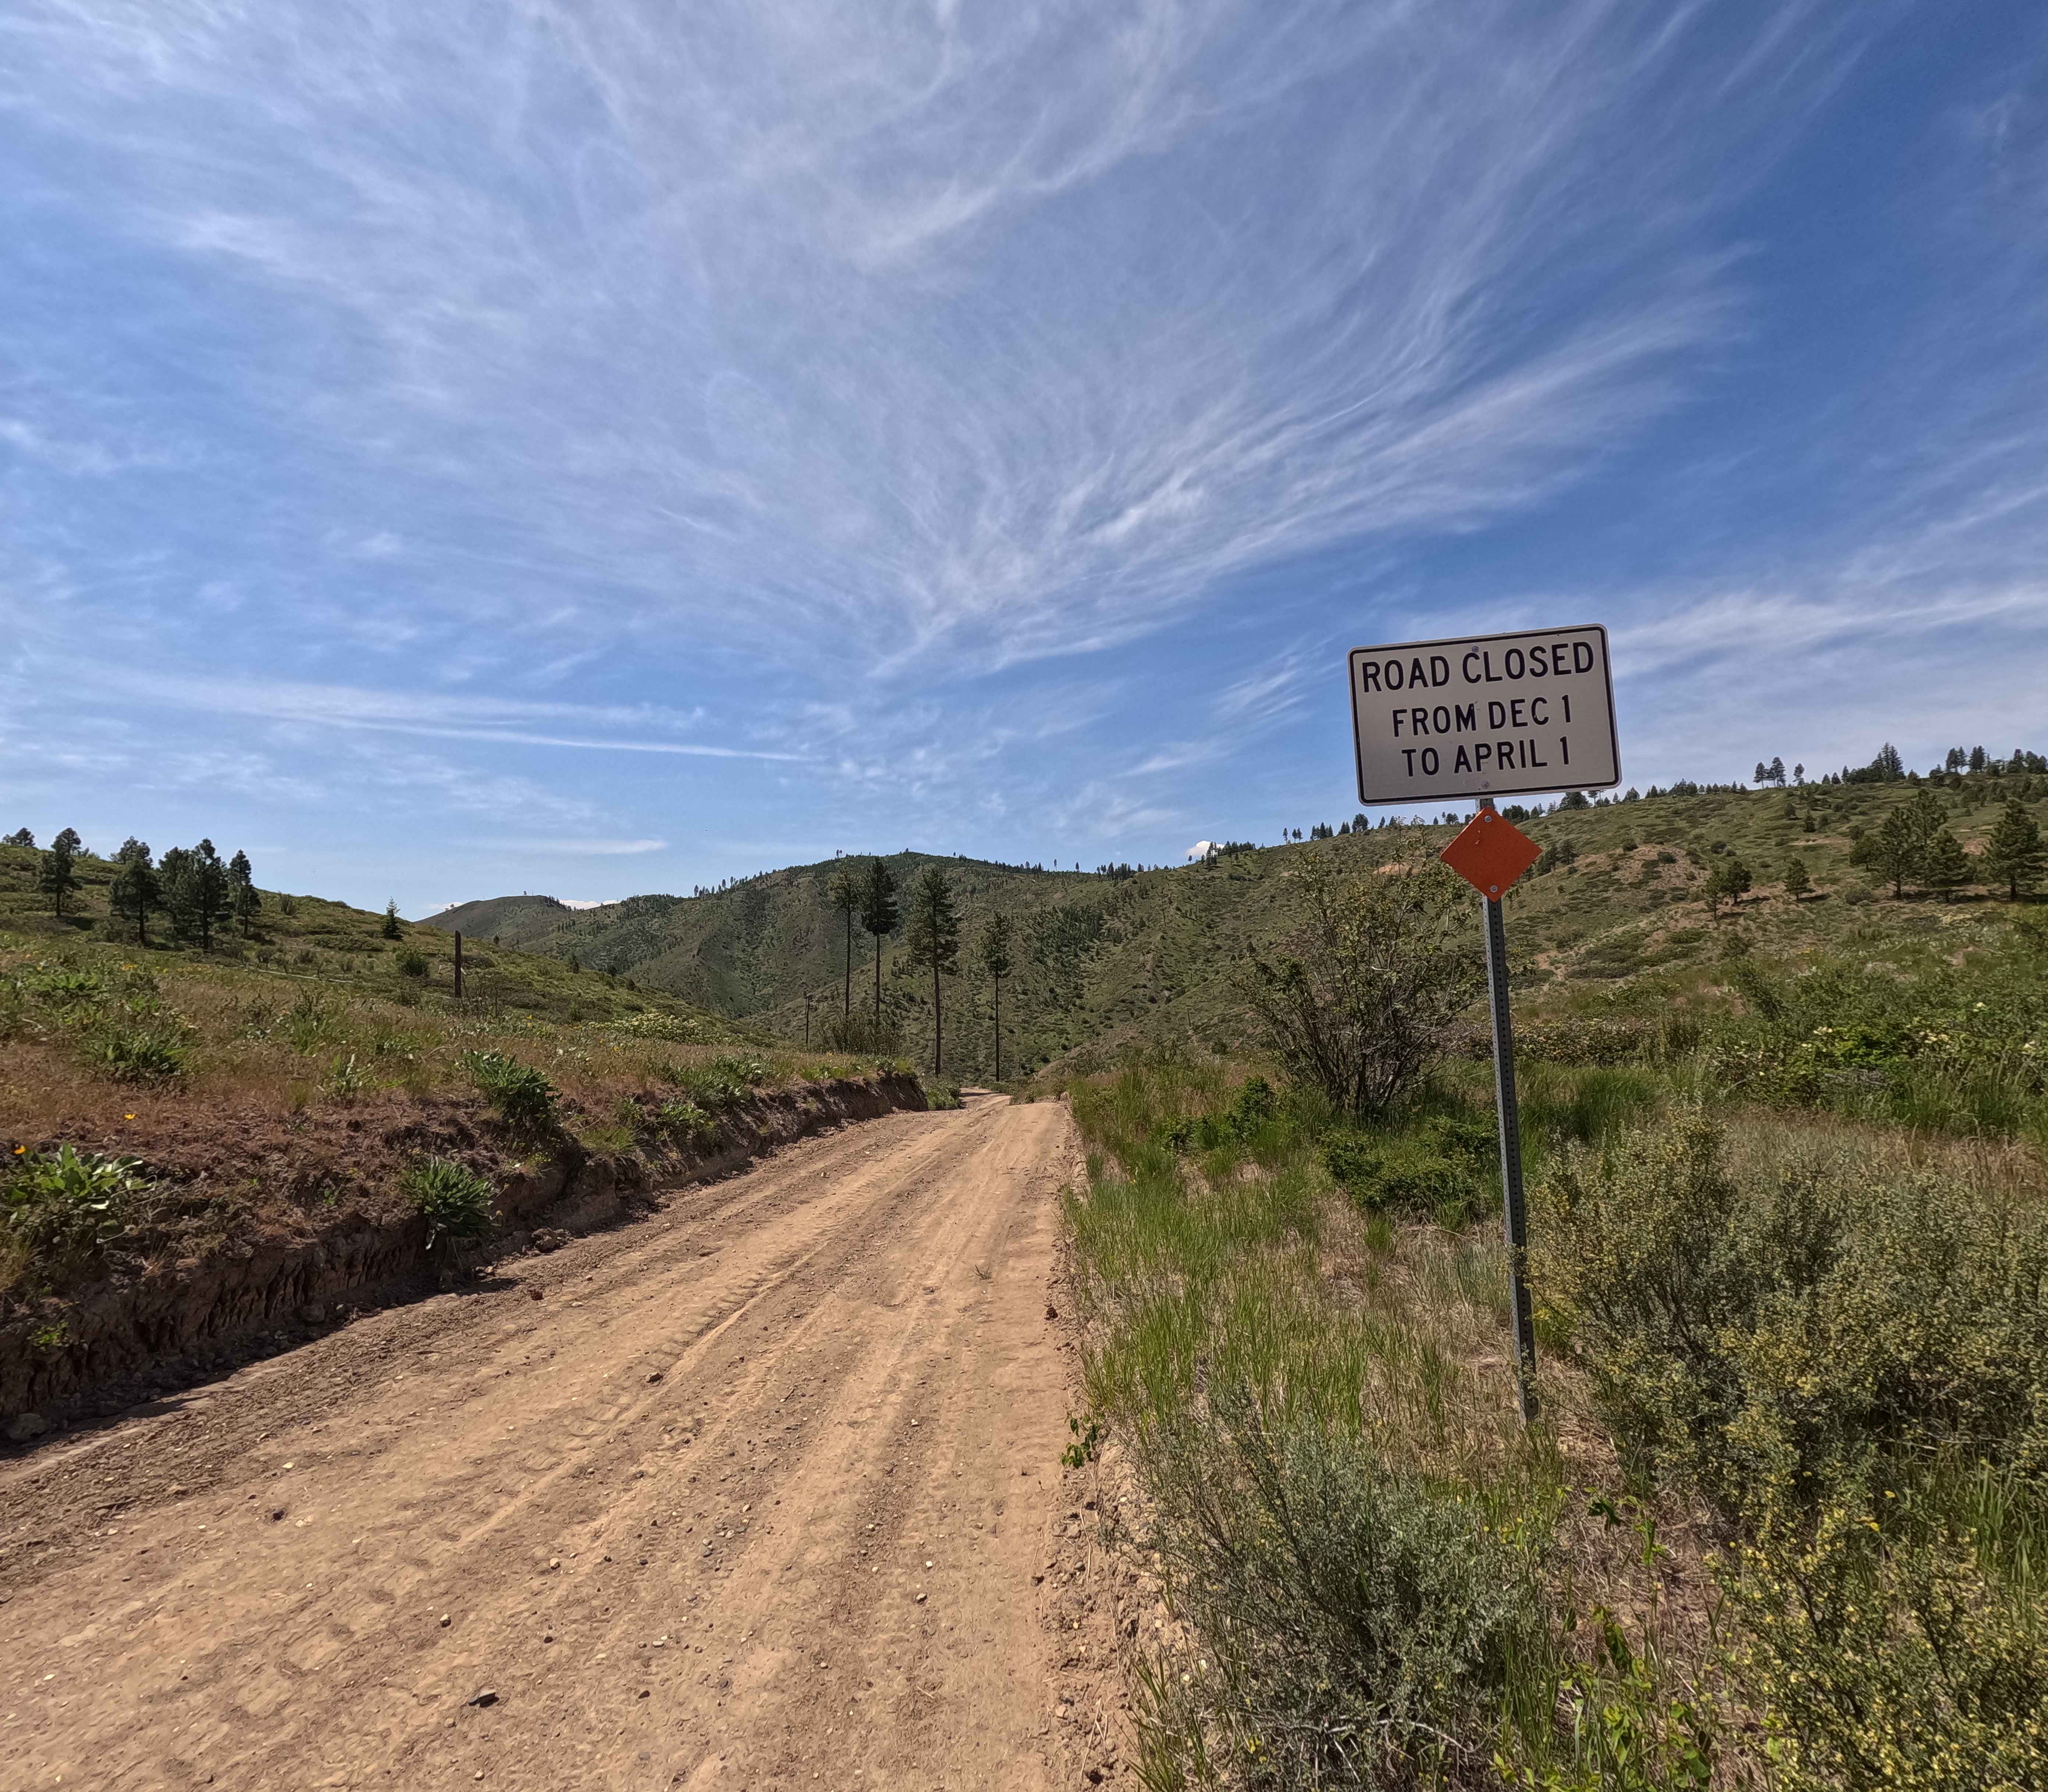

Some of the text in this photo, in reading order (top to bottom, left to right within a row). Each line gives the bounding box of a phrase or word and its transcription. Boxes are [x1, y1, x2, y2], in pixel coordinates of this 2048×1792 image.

[1362, 641, 1594, 693] ROAD CLOSED
[1392, 694, 1571, 737] FROM DEC 1
[1401, 736, 1569, 777] TO APRIL 1
